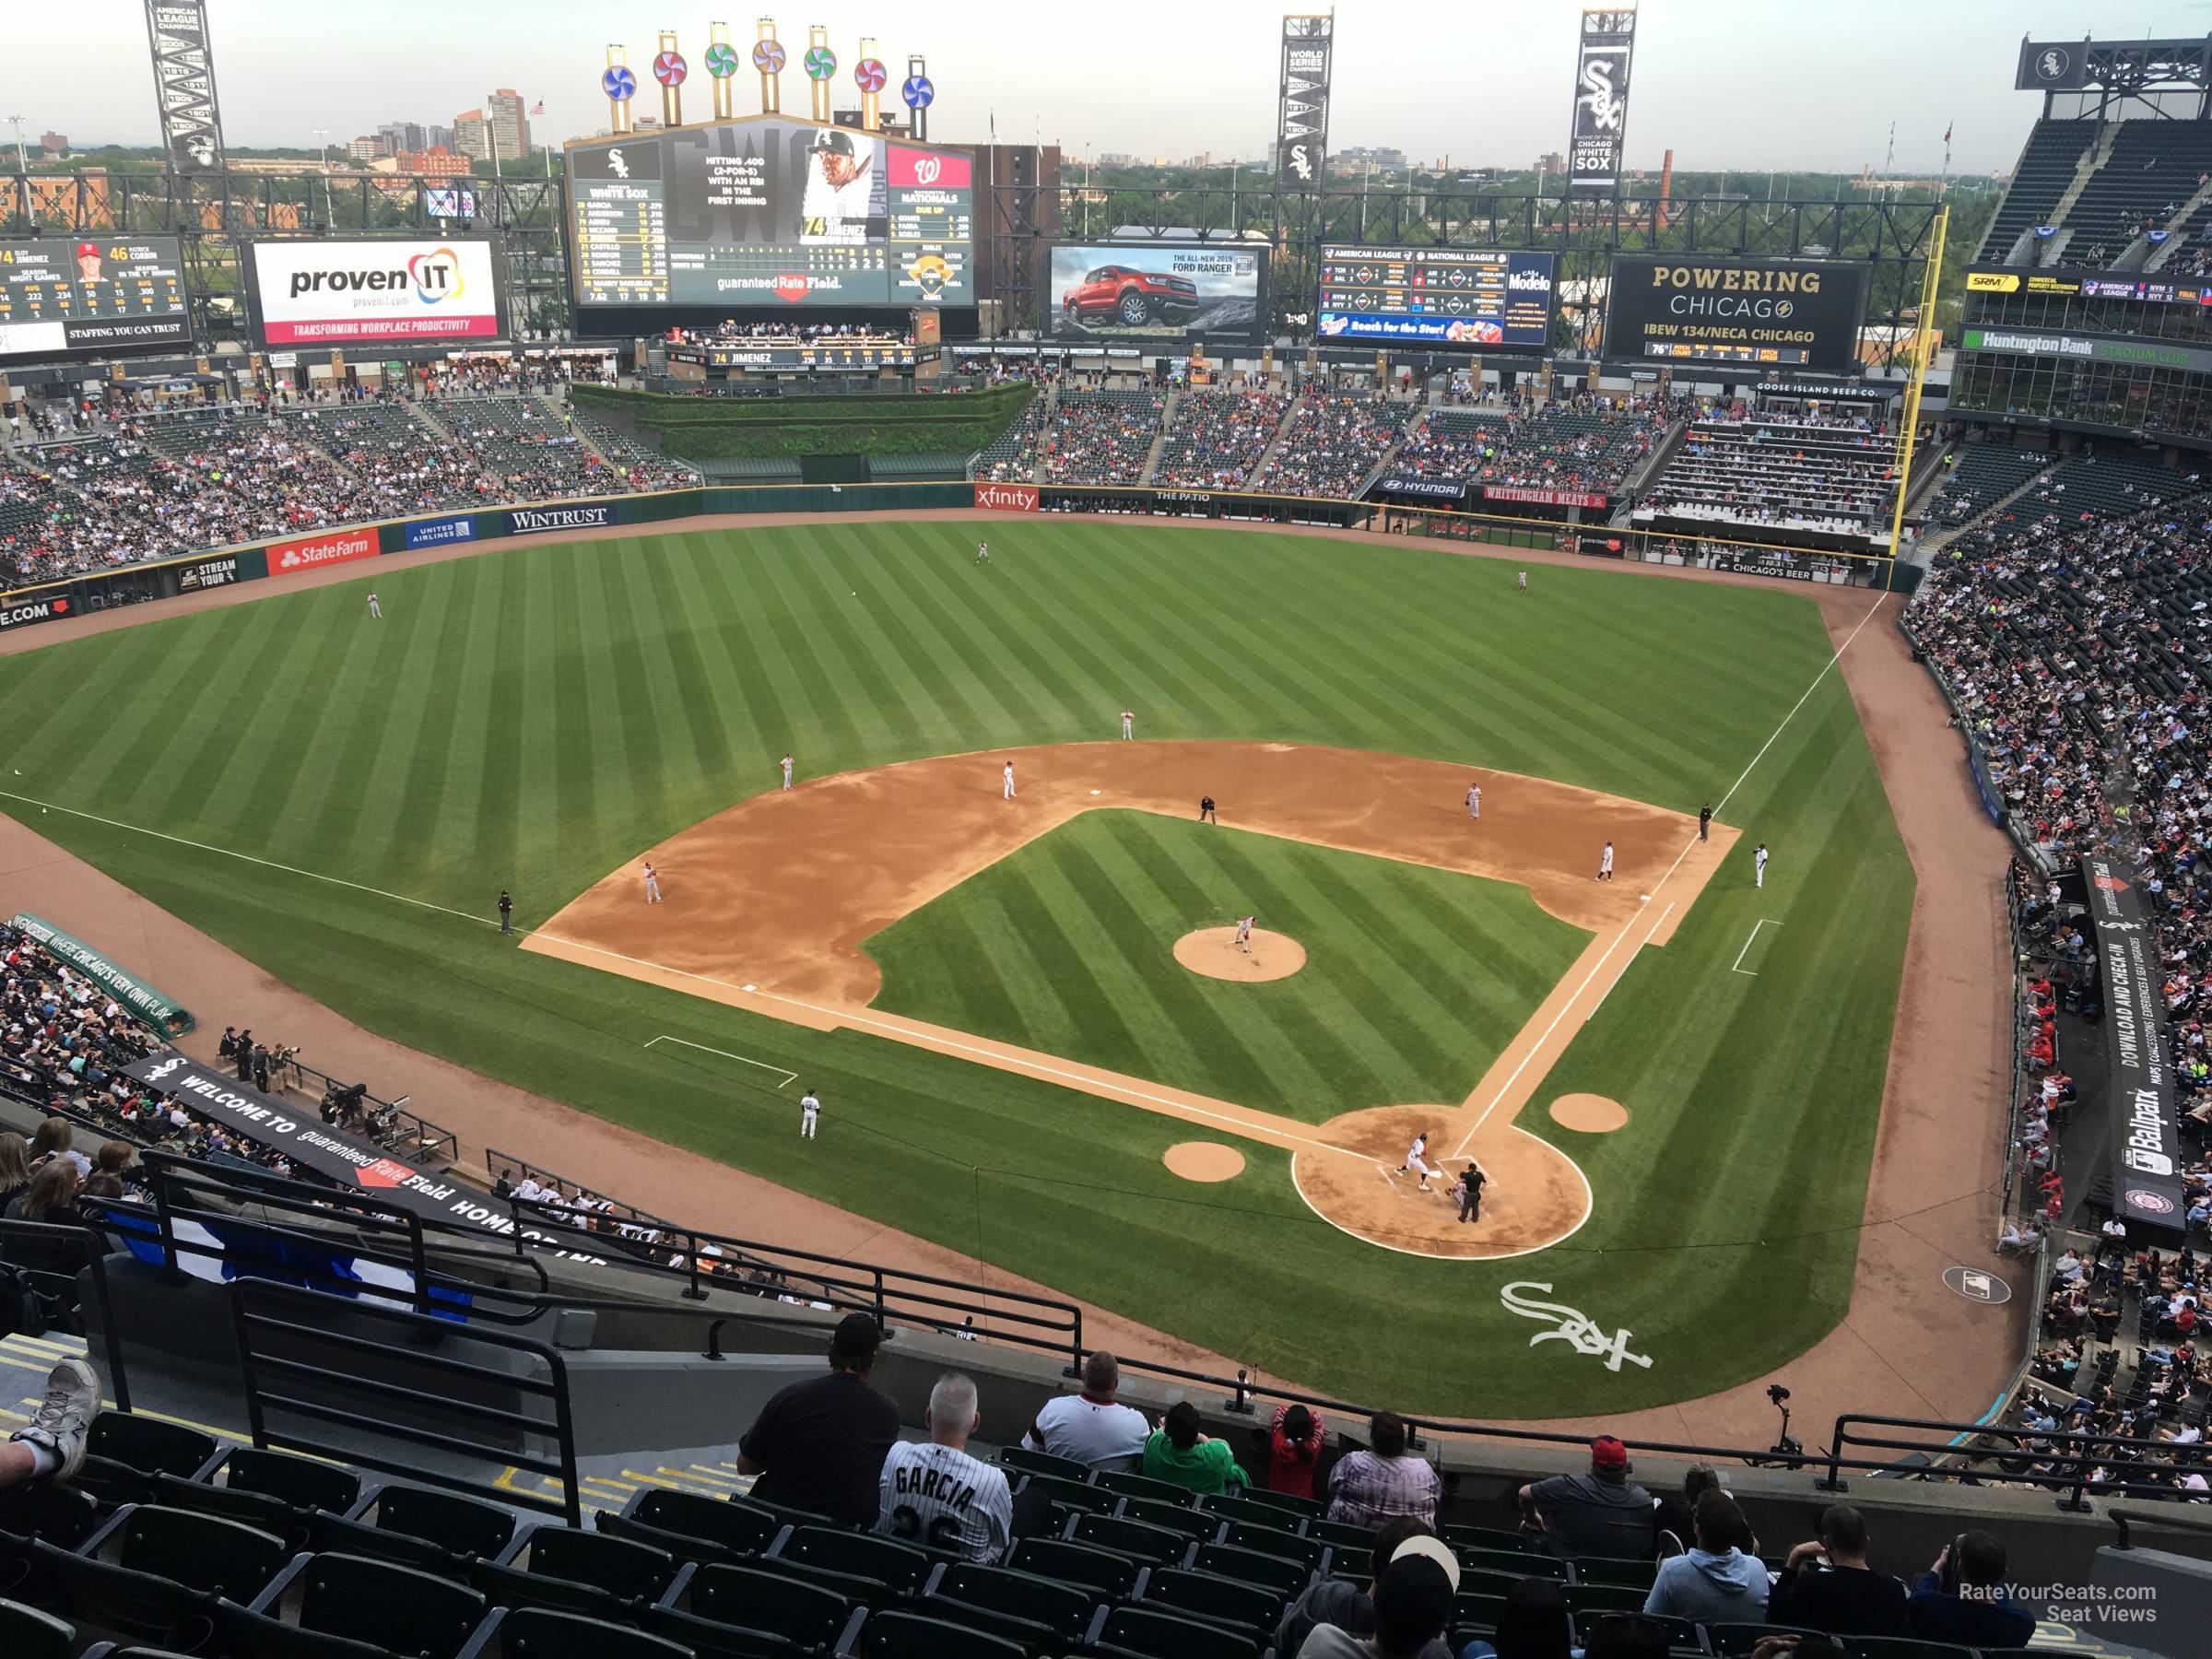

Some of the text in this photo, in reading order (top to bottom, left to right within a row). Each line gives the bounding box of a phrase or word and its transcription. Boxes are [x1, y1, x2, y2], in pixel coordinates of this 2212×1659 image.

[158, 15, 198, 24] LEAGUE
[1577, 148, 1611, 157] WHITE
[706, 157, 764, 166] HITTING .400
[1576, 158, 1610, 171] SOX
[708, 176, 764, 186] WITH AN RBI
[590, 189, 649, 198] WHITE SOX
[735, 187, 751, 195] THE
[708, 196, 767, 206] FIRST INNING
[901, 194, 958, 204] NATIONALS
[804, 218, 824, 235] 74
[825, 225, 865, 236] JIMENEZ
[17, 255, 49, 264] JIMENEZ
[110, 247, 128, 261] 46
[1335, 250, 1371, 258] AMERICAN
[1198, 264, 1232, 273] RANGER
[290, 265, 448, 298] proven IT
[718, 276, 842, 290] guaranteed Rate Field.
[1509, 274, 1550, 290] Modelo
[1653, 266, 1821, 293] POWERING
[1973, 276, 2001, 287] SRM
[2100, 283, 2134, 291] AMERICAN
[55, 291, 72, 300] .234
[2178, 290, 2197, 299] FINAL
[1670, 295, 1794, 318] CHICAGO
[1286, 313, 1308, 325] 7:40
[70, 324, 181, 339] STAFFING YOU CAN TRUST
[294, 319, 470, 335] TRANSFORMING WORKPLACE PRODUCTIVITY
[1383, 322, 1400, 333] for
[1400, 324, 1418, 333] the
[1419, 324, 1445, 335] Star!
[1644, 323, 1815, 343] IBEW 134/NECA CHICAGO
[1652, 344, 1669, 355] 76°
[1983, 332, 2092, 355] Huntington Bank
[714, 354, 726, 363] 74
[732, 353, 771, 363] JIMENEZ
[2100, 346, 2188, 365] STADIUM CLUB
[1758, 382, 1878, 397] GOOSE ISLAND BEER CO.
[1405, 482, 1459, 495] HYUNDAI
[978, 487, 1036, 511] xfinity
[1157, 491, 1210, 502] THE PATIO
[1487, 488, 1553, 503] WHITTINGHAM
[1558, 491, 1589, 506] MEATS
[419, 524, 454, 535] UNITED
[412, 531, 455, 543] AIRLINES
[198, 559, 236, 575] STREAM
[1733, 563, 1810, 580] CHICAGO'S BEER
[200, 572, 225, 587] YOUR
[0, 604, 49, 626] E.COM
[2129, 936, 2144, 962] UPGRADES
[49, 935, 79, 957] WHERE
[72, 949, 116, 981] CHICAGO'S
[110, 972, 134, 994] VERY
[128, 987, 151, 1008] OWN
[2135, 962, 2147, 977] SEAT
[2108, 943, 2140, 1068] DOWNLOAD AND CHECK-IN
[2139, 981, 2154, 1018] EXPERIENCES
[2143, 1020, 2161, 1063] CONCESSIONS
[2149, 1065, 2162, 1086] MAPS
[2129, 1088, 2168, 1153] Ballpark
[180, 1074, 456, 1201] WELCOME TO guaranteed Rate Field
[896, 1466, 976, 1513] GARCIA
